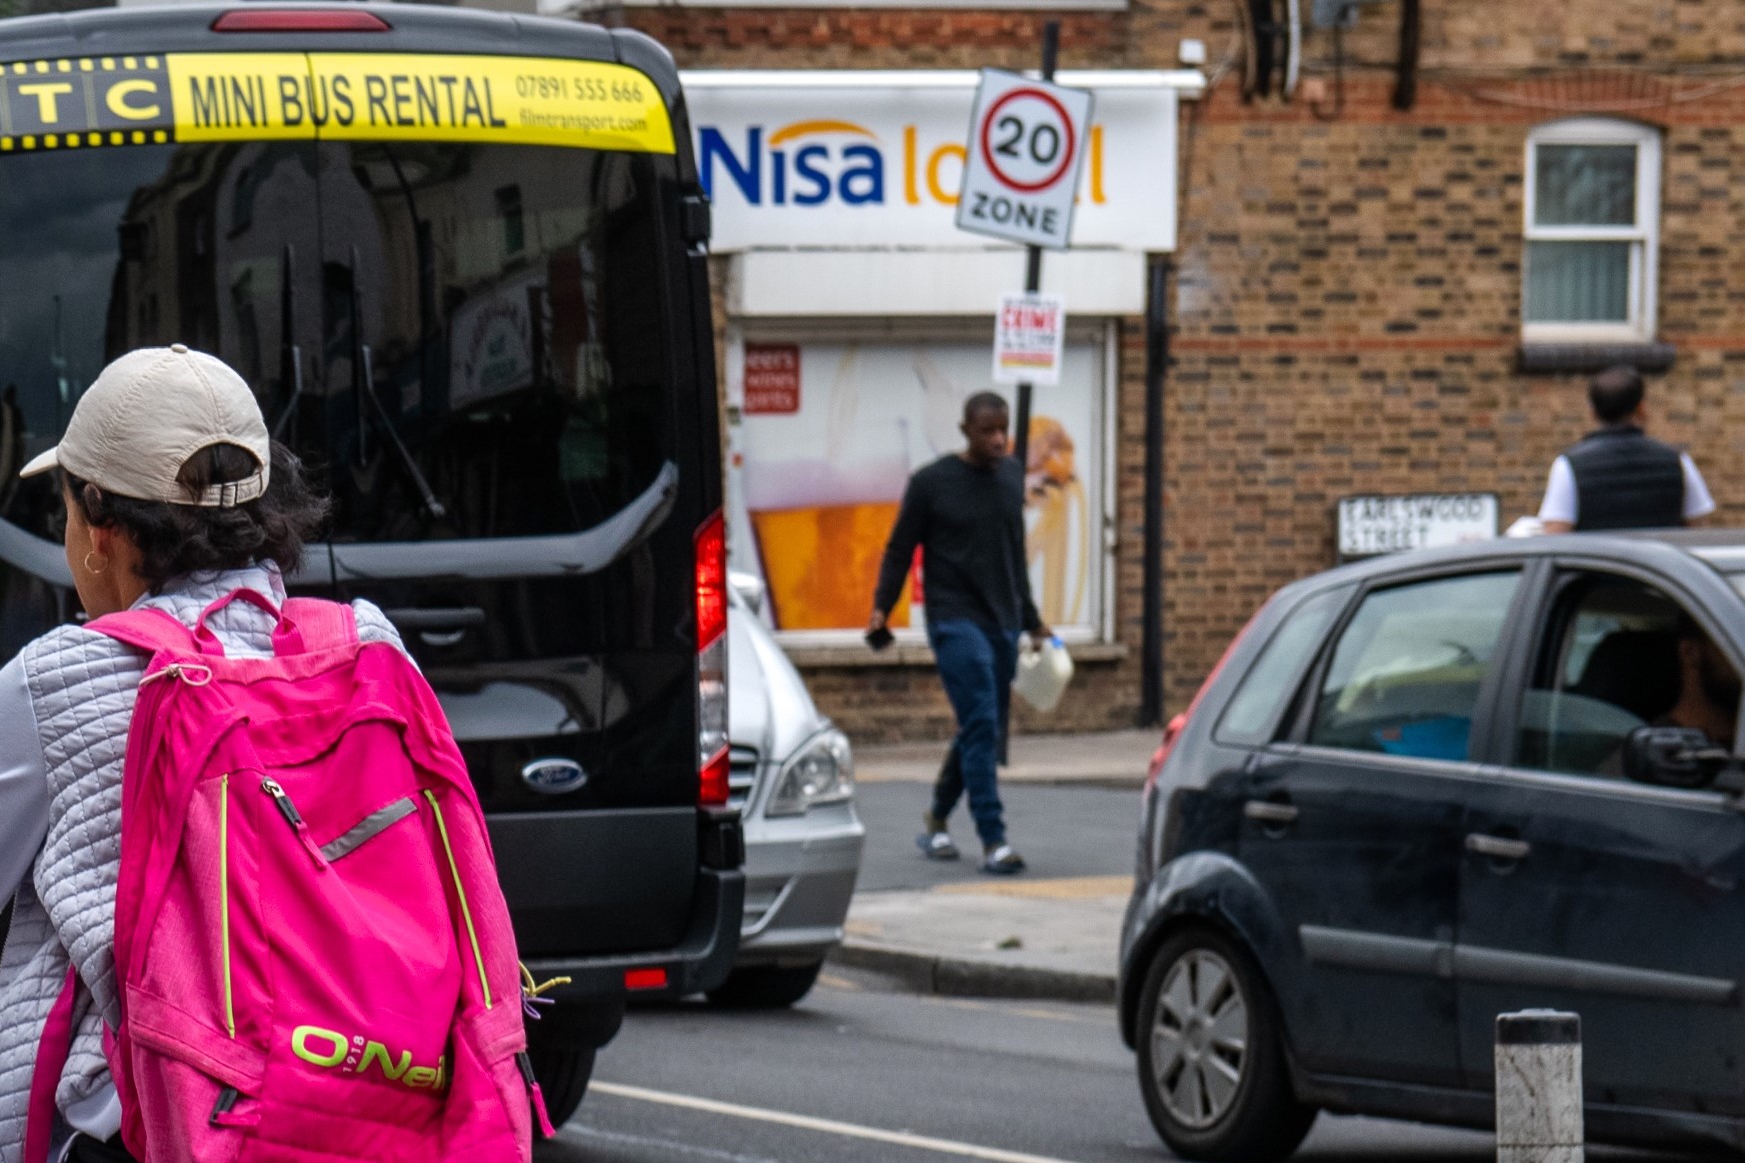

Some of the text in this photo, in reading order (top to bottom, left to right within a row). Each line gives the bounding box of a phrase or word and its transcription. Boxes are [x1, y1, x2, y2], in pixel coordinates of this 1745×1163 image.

[189, 74, 507, 128] MINI BUS RENTAL
[515, 74, 644, 103] 07891 555 666
[519, 108, 647, 136] filmtransport.com
[995, 115, 1061, 165] 20
[698, 121, 1107, 207] Nisa lol
[971, 192, 1058, 236] ZONE
[1345, 496, 1486, 523] EARLSWOOD
[1344, 524, 1429, 551] STREET
